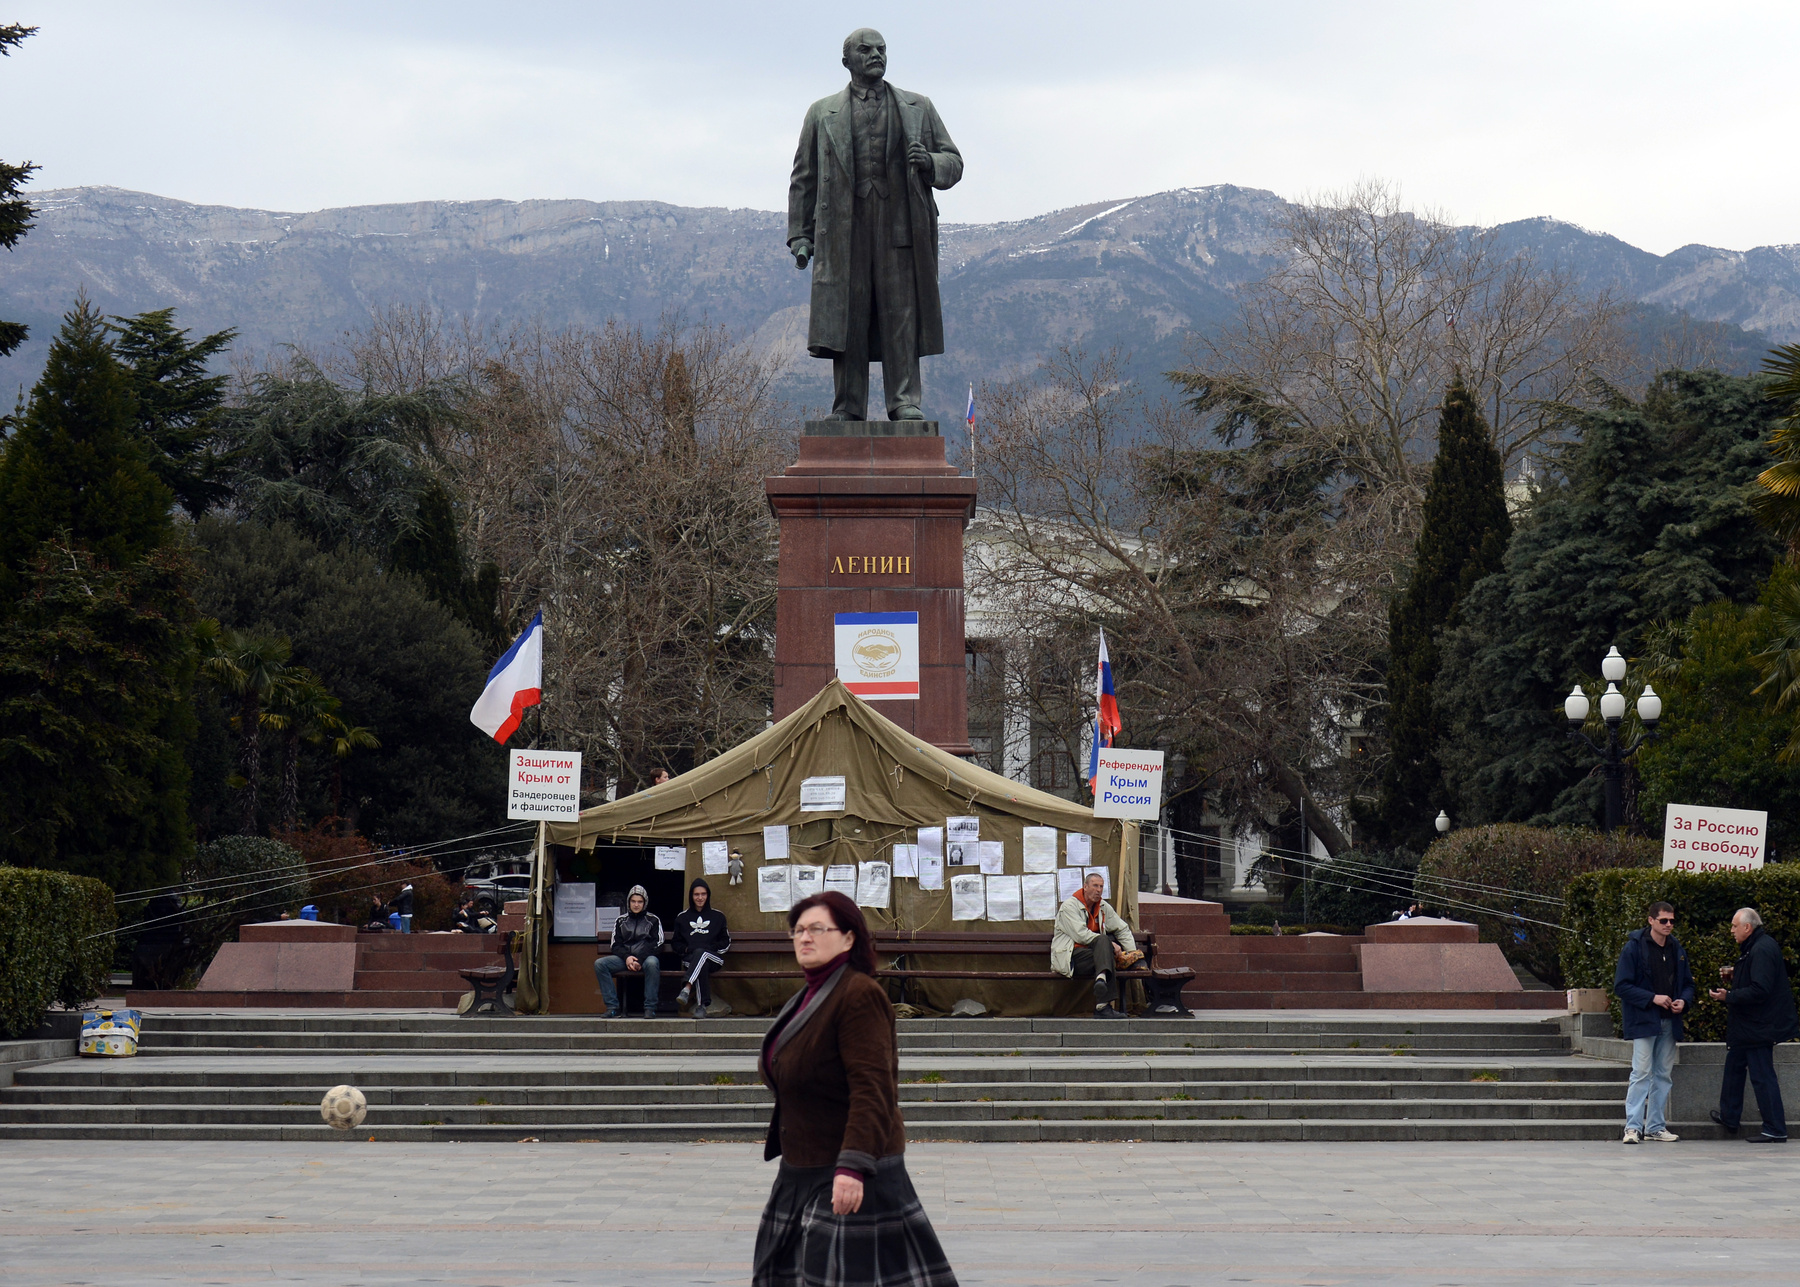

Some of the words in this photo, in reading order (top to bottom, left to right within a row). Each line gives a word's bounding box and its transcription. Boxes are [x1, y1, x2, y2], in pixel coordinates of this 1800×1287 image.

[831, 556, 910, 573] ЛЕНИН
[857, 628, 896, 638] НАРОДНОЕ
[859, 668, 896, 679] ЕДИНСТВО
[516, 755, 573, 769] Защитим
[1099, 759, 1162, 772] Референдум
[518, 771, 553, 784] Крым
[557, 775, 571, 784] от
[1110, 775, 1148, 789] Крым
[512, 790, 576, 801] Бандеровцев
[1104, 791, 1151, 805] Россия
[520, 802, 576, 813] фашистов!
[1673, 817, 1692, 830] За
[1698, 819, 1759, 836] Россию
[1670, 839, 1686, 849] за
[1691, 840, 1760, 858] свободу
[1676, 859, 1696, 870] до
